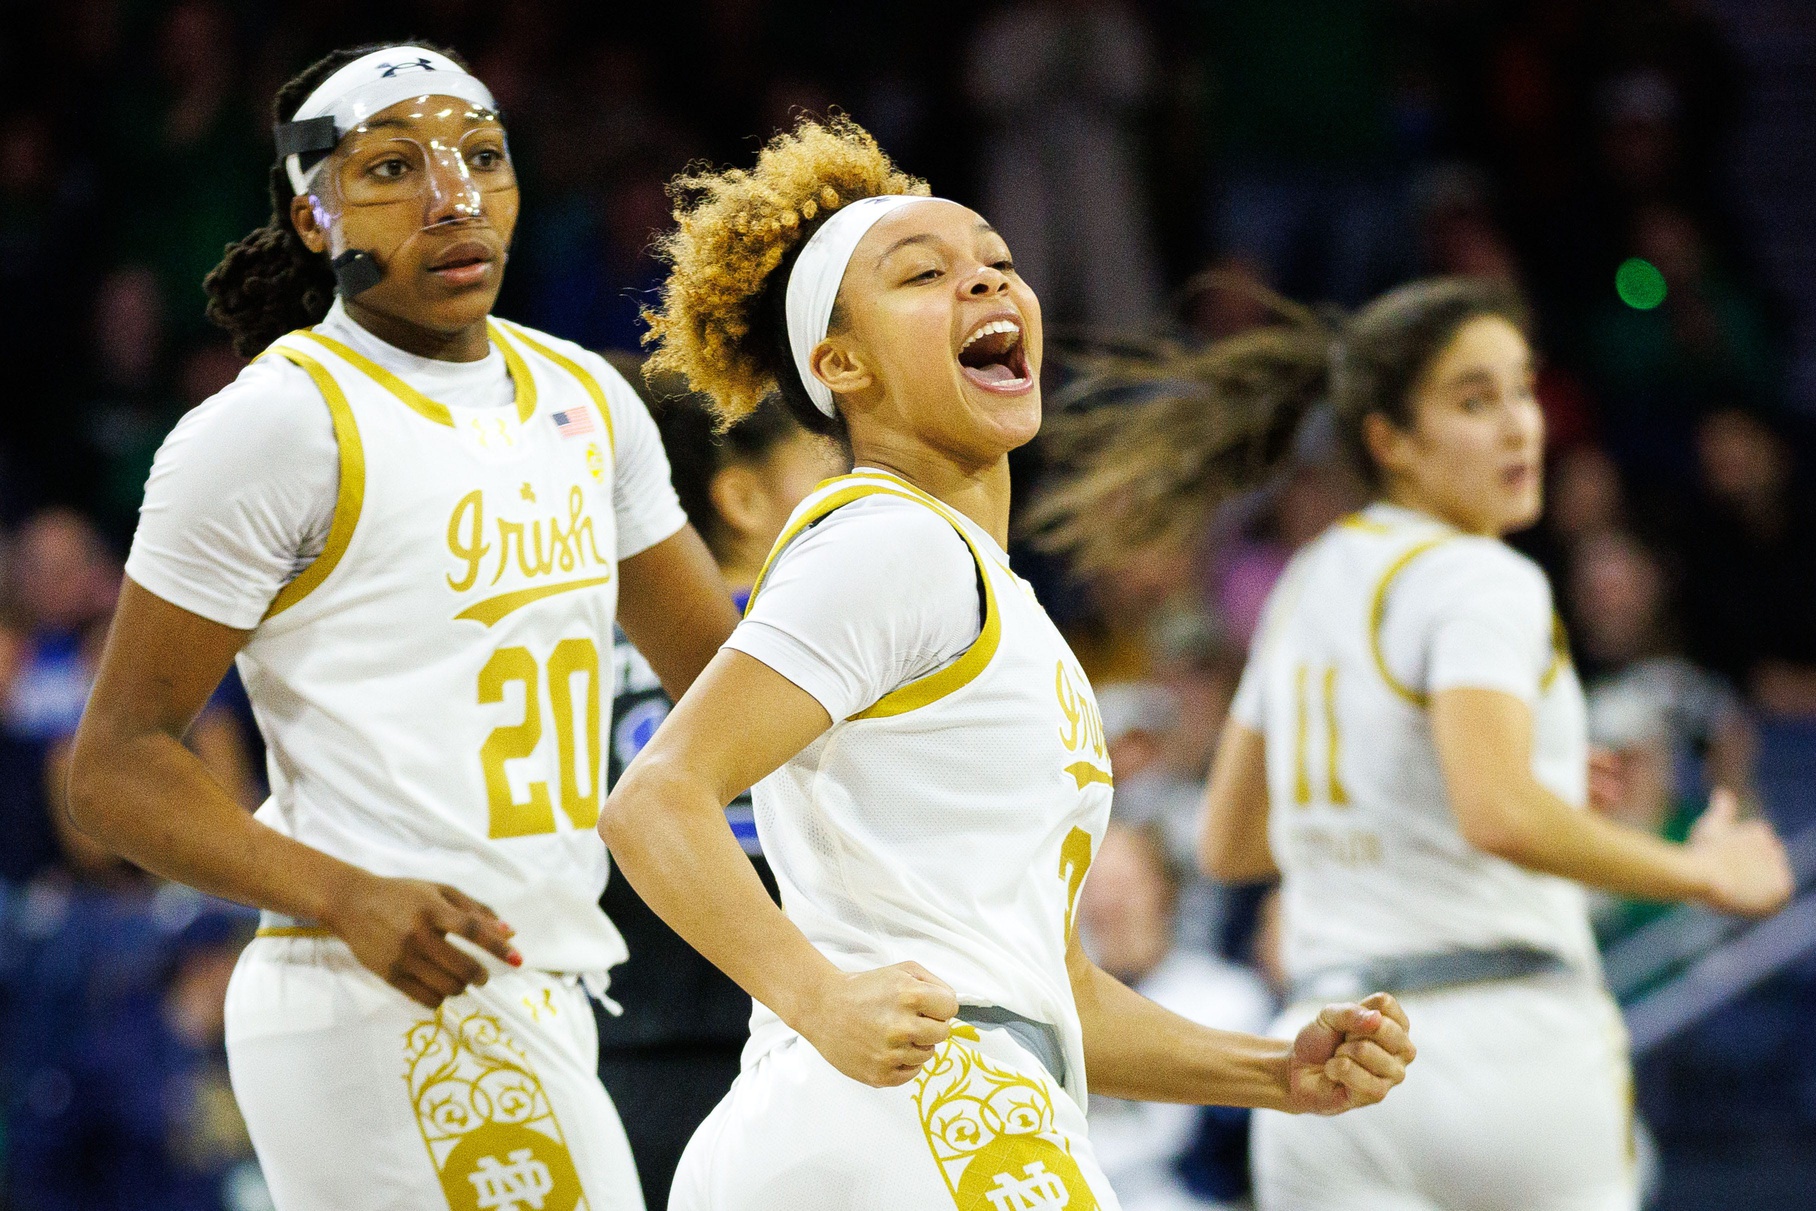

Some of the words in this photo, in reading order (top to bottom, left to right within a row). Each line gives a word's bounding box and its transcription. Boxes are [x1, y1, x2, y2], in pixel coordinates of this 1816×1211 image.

[446, 484, 610, 593] Irish
[477, 637, 600, 840] 20
[1293, 664, 1349, 806] 11
[468, 1147, 554, 1211] ND
[984, 1160, 1070, 1211] ND
